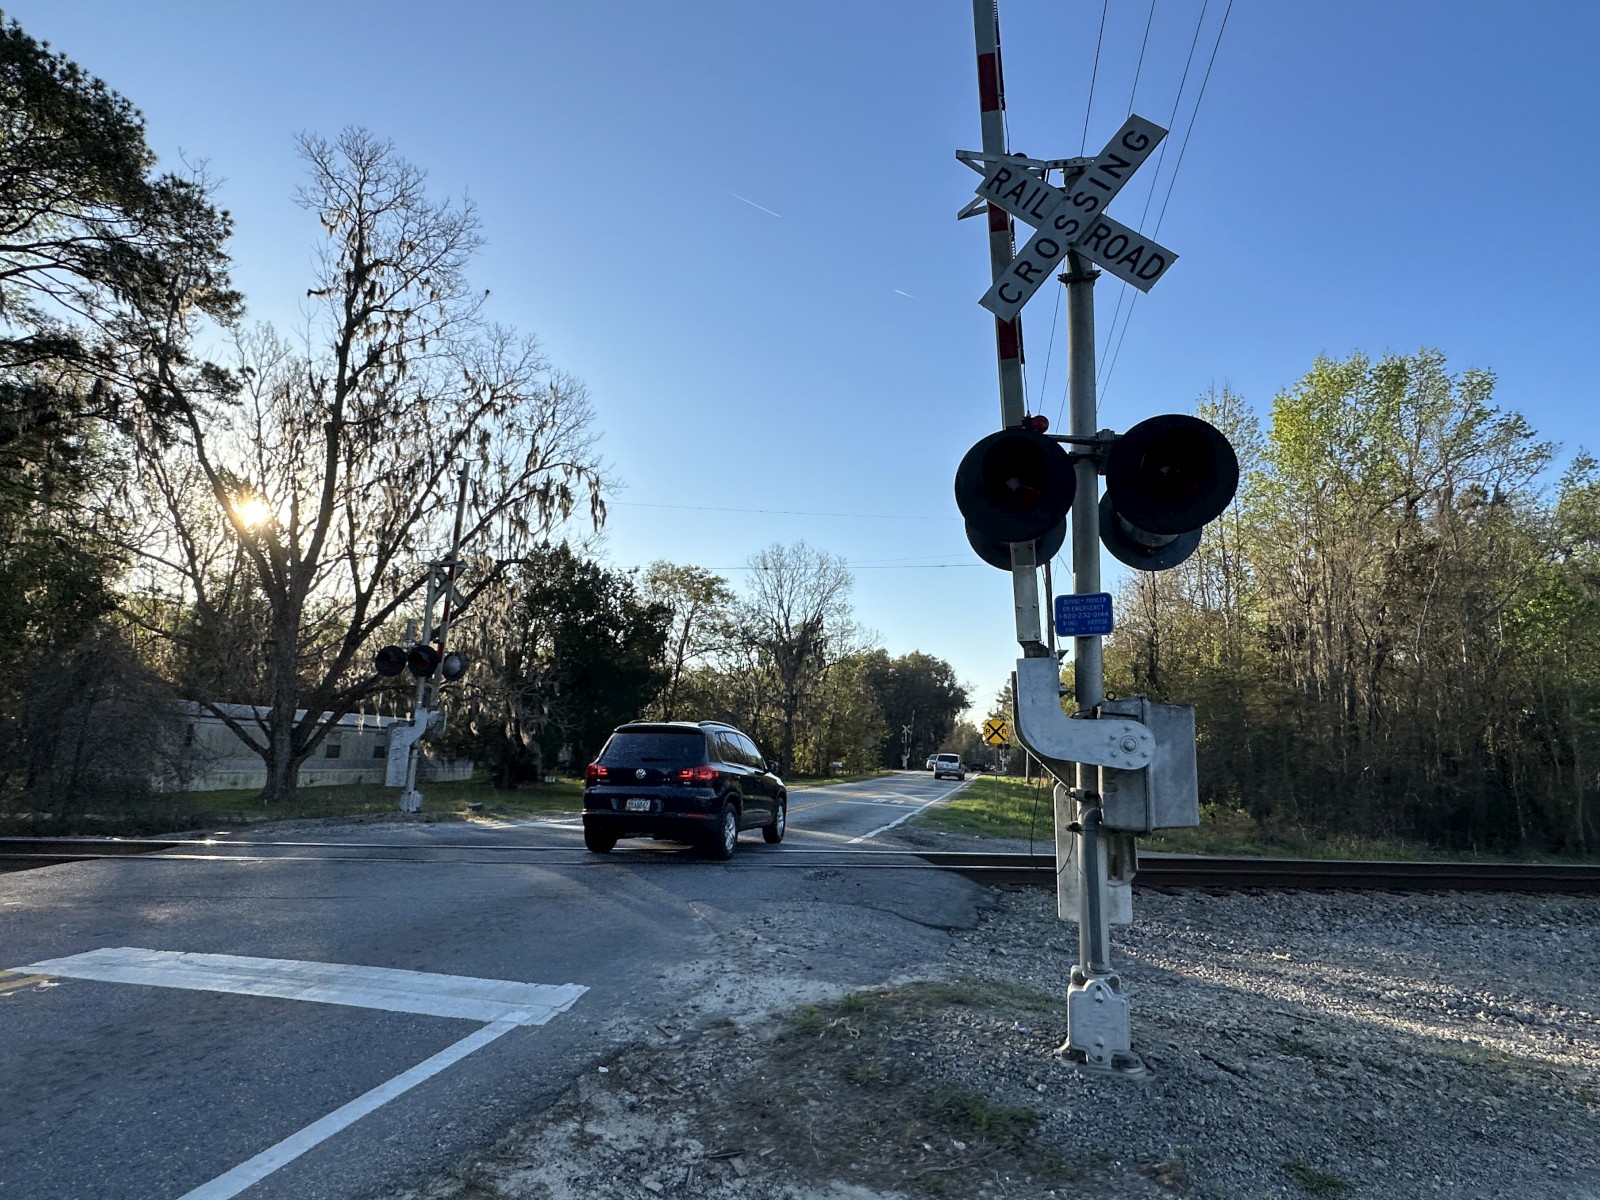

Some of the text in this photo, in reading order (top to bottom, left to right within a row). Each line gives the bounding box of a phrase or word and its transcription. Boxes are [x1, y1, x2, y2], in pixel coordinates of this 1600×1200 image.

[986, 166, 1166, 281] RAIL ROAD
[998, 130, 1149, 304] CROSSING
